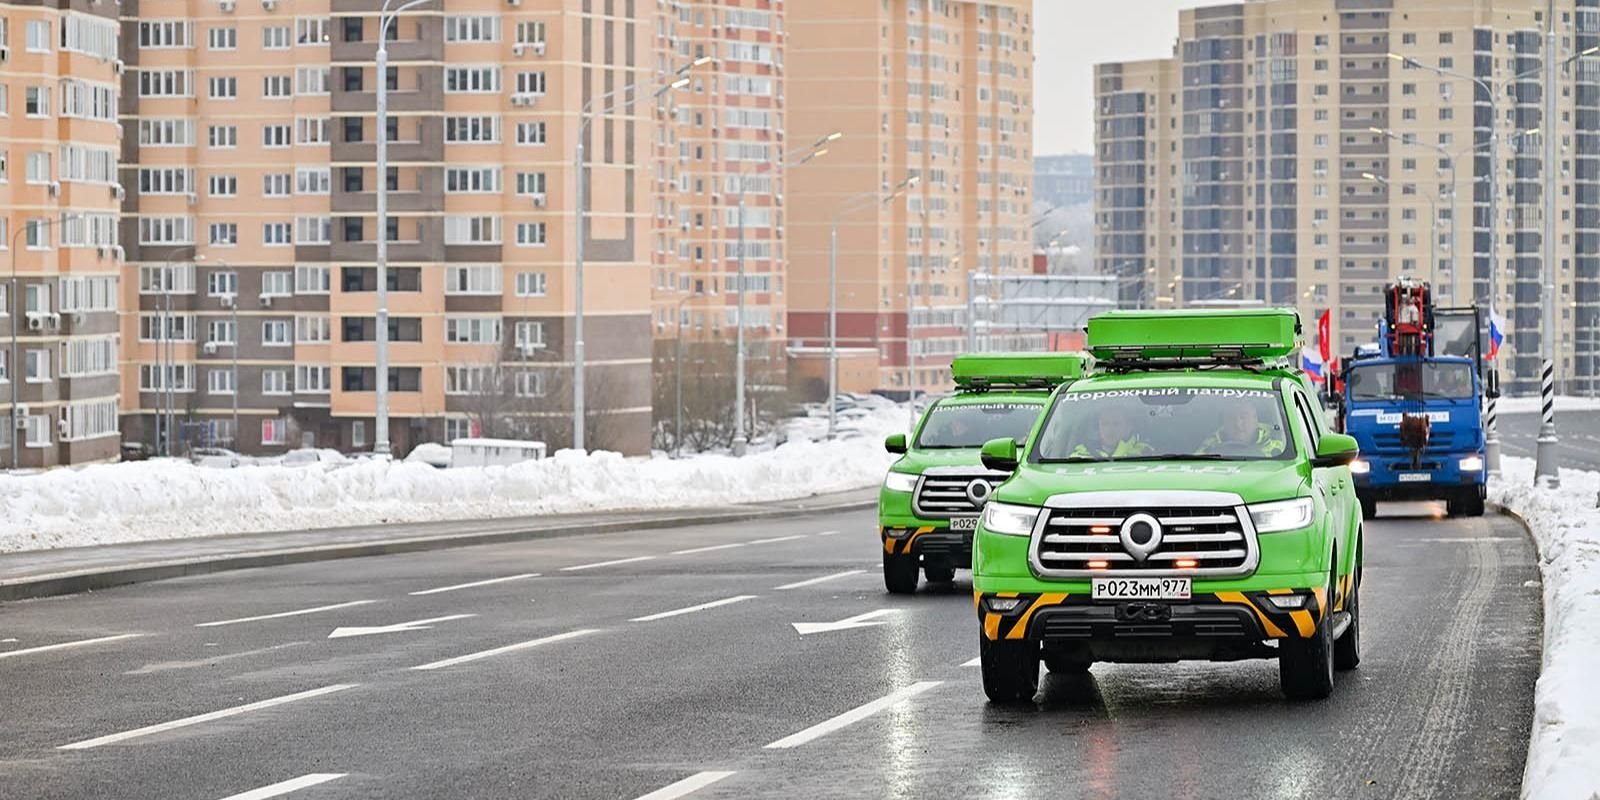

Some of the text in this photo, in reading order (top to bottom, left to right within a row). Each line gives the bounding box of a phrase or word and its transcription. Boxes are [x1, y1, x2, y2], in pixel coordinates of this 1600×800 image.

[1063, 387, 1275, 403] Дорожный патруль
[1162, 579, 1187, 592] 977
